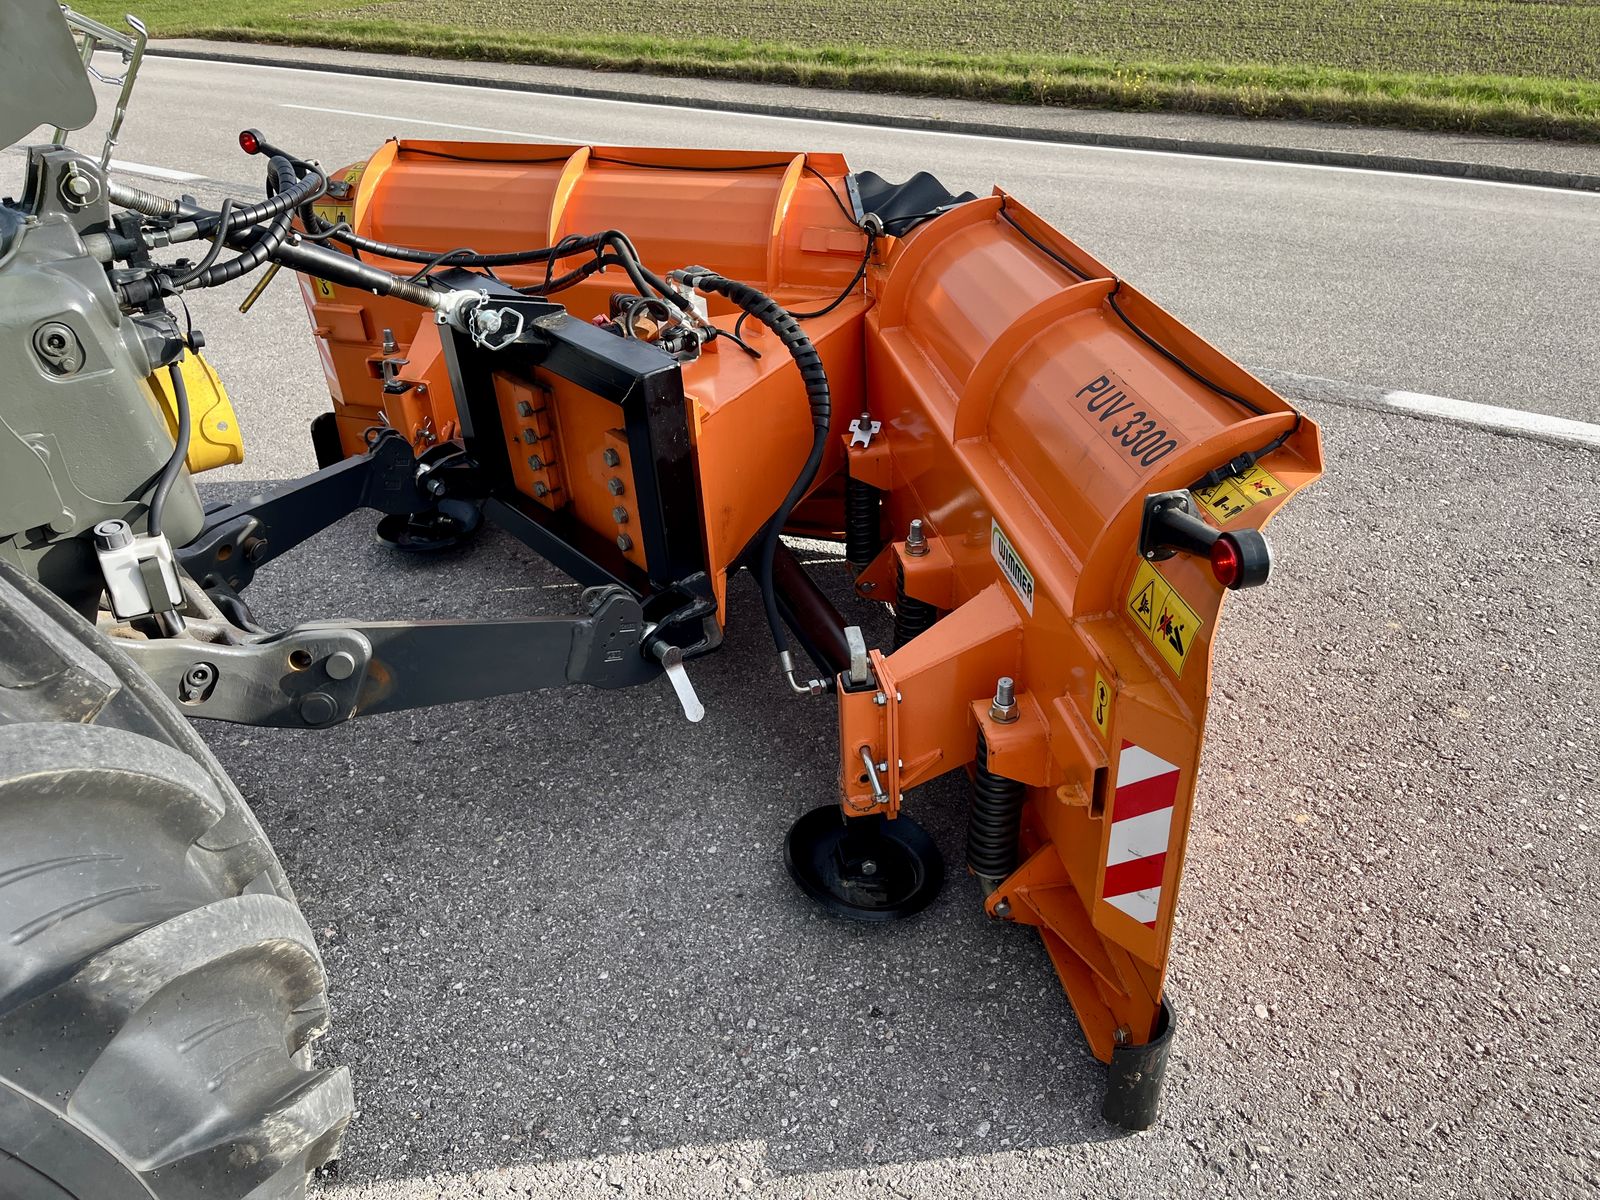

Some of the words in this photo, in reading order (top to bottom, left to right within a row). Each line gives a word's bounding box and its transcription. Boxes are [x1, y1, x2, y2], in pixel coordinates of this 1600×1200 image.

[1075, 375, 1135, 422] PUV
[1112, 411, 1177, 467] 3300
[998, 537, 1033, 603] WIMMER
